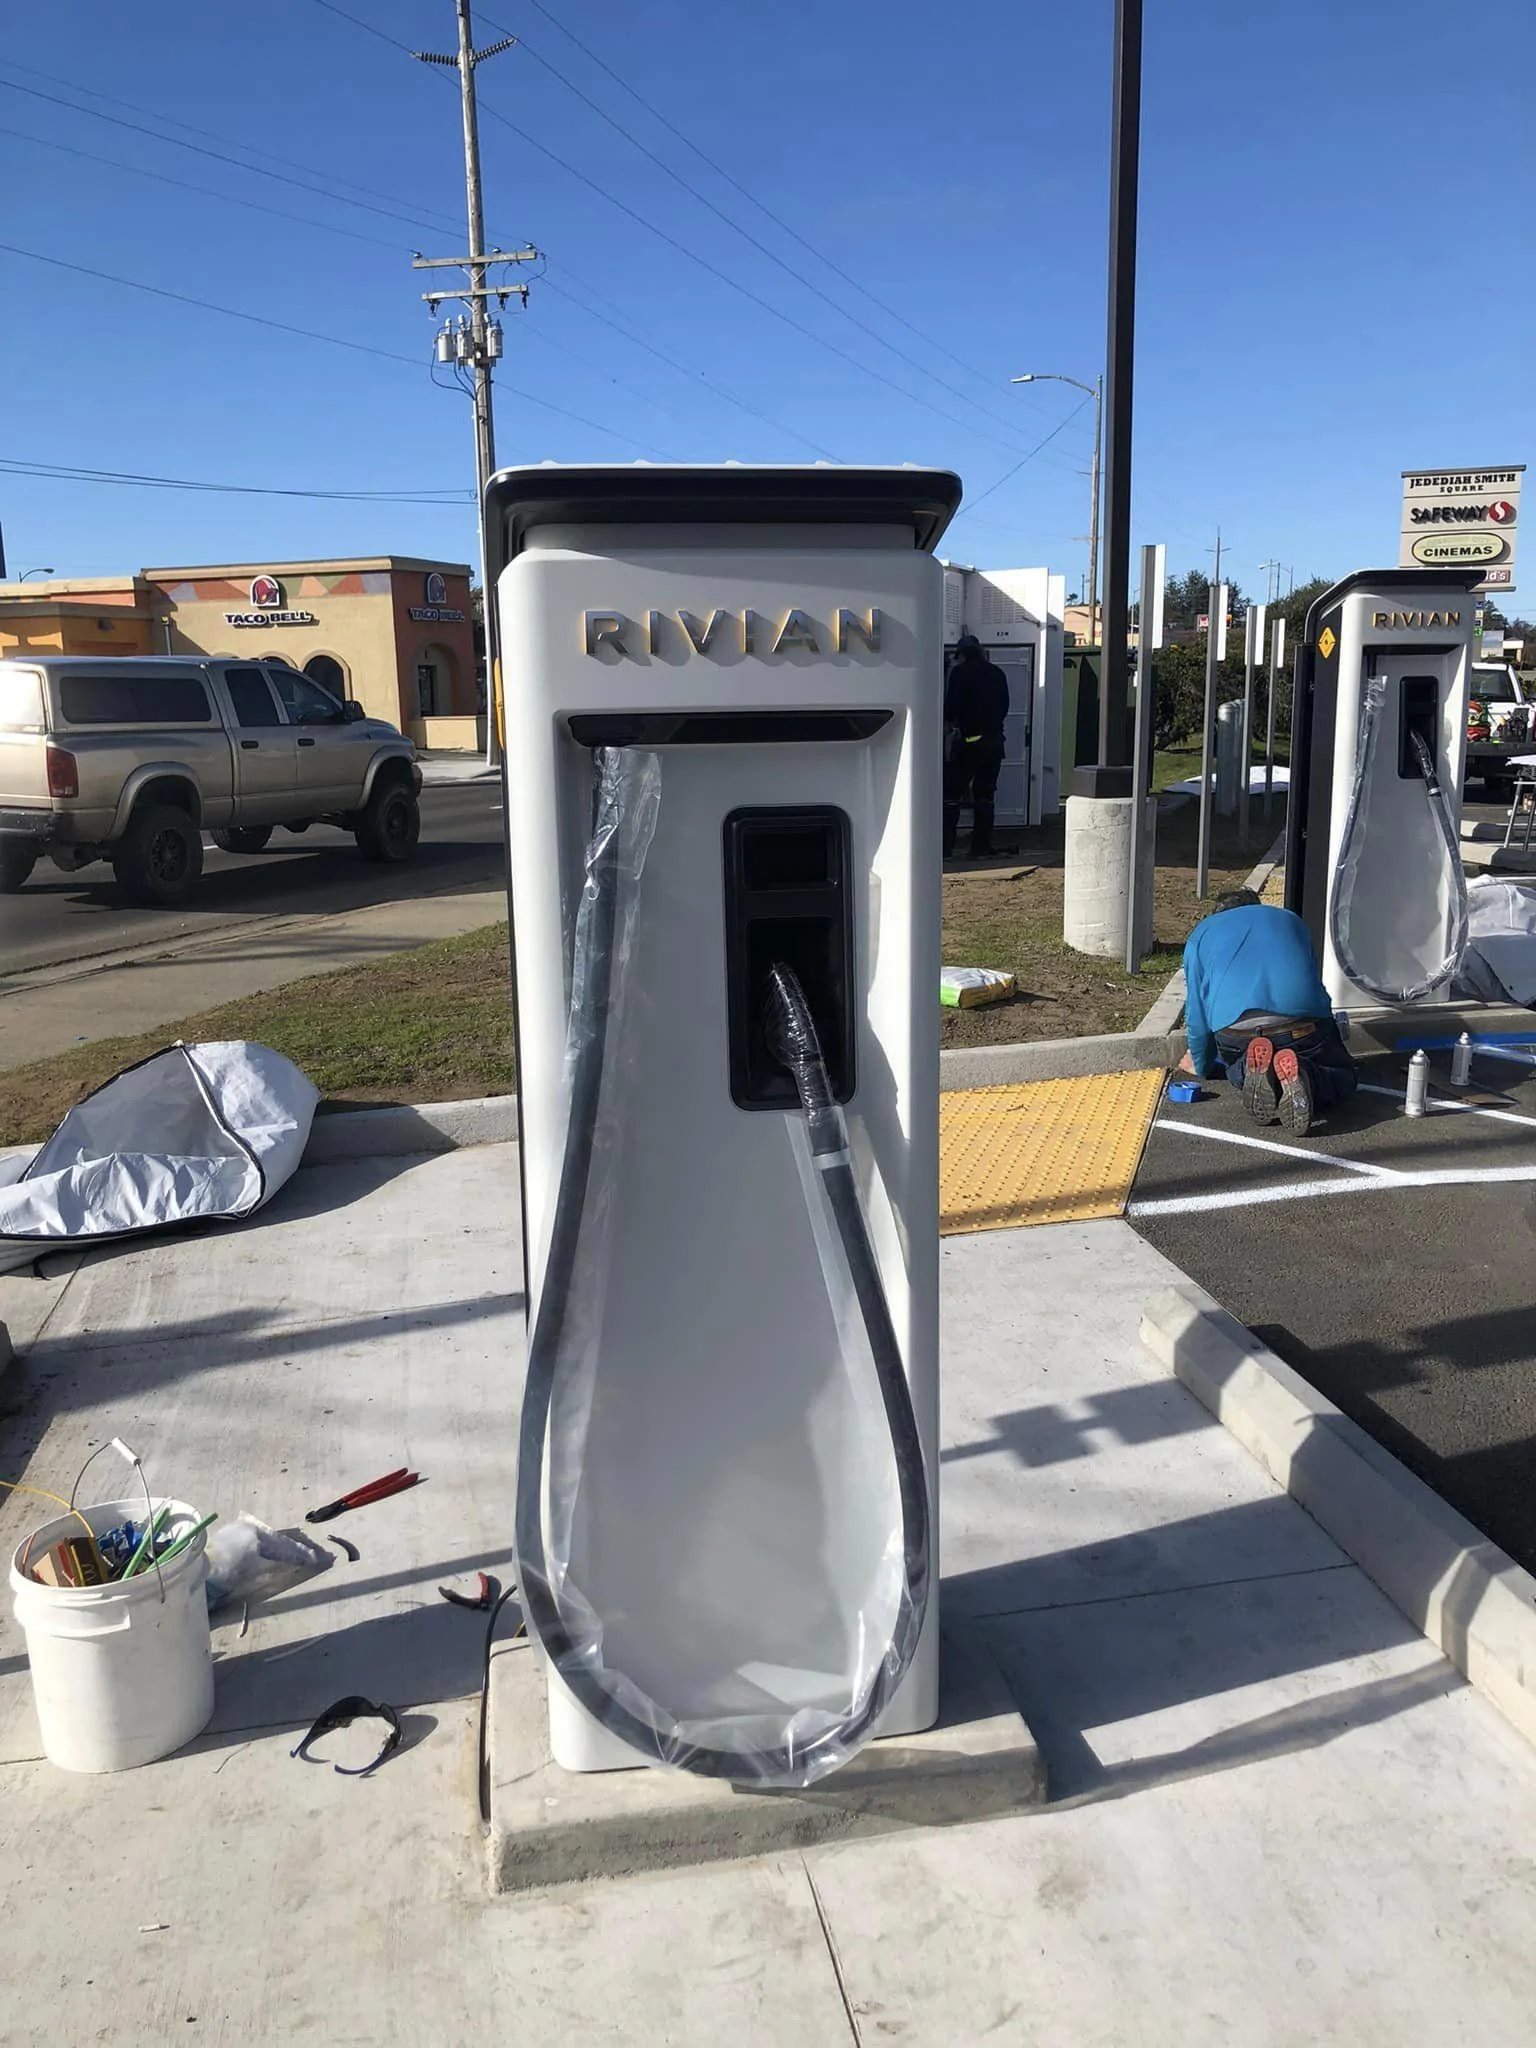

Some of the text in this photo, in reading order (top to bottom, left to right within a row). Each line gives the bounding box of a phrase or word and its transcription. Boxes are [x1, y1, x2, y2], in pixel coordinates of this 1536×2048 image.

[1410, 473, 1516, 488] JEDEDIAH SMITH
[1440, 485, 1484, 493] SQUARE
[1410, 505, 1487, 522] SAFEWAY
[1423, 546, 1493, 557] CINEMAS
[225, 612, 310, 624] TACO BELL
[1372, 611, 1461, 627] RIVIAN
[584, 608, 881, 653] RIVIAN
